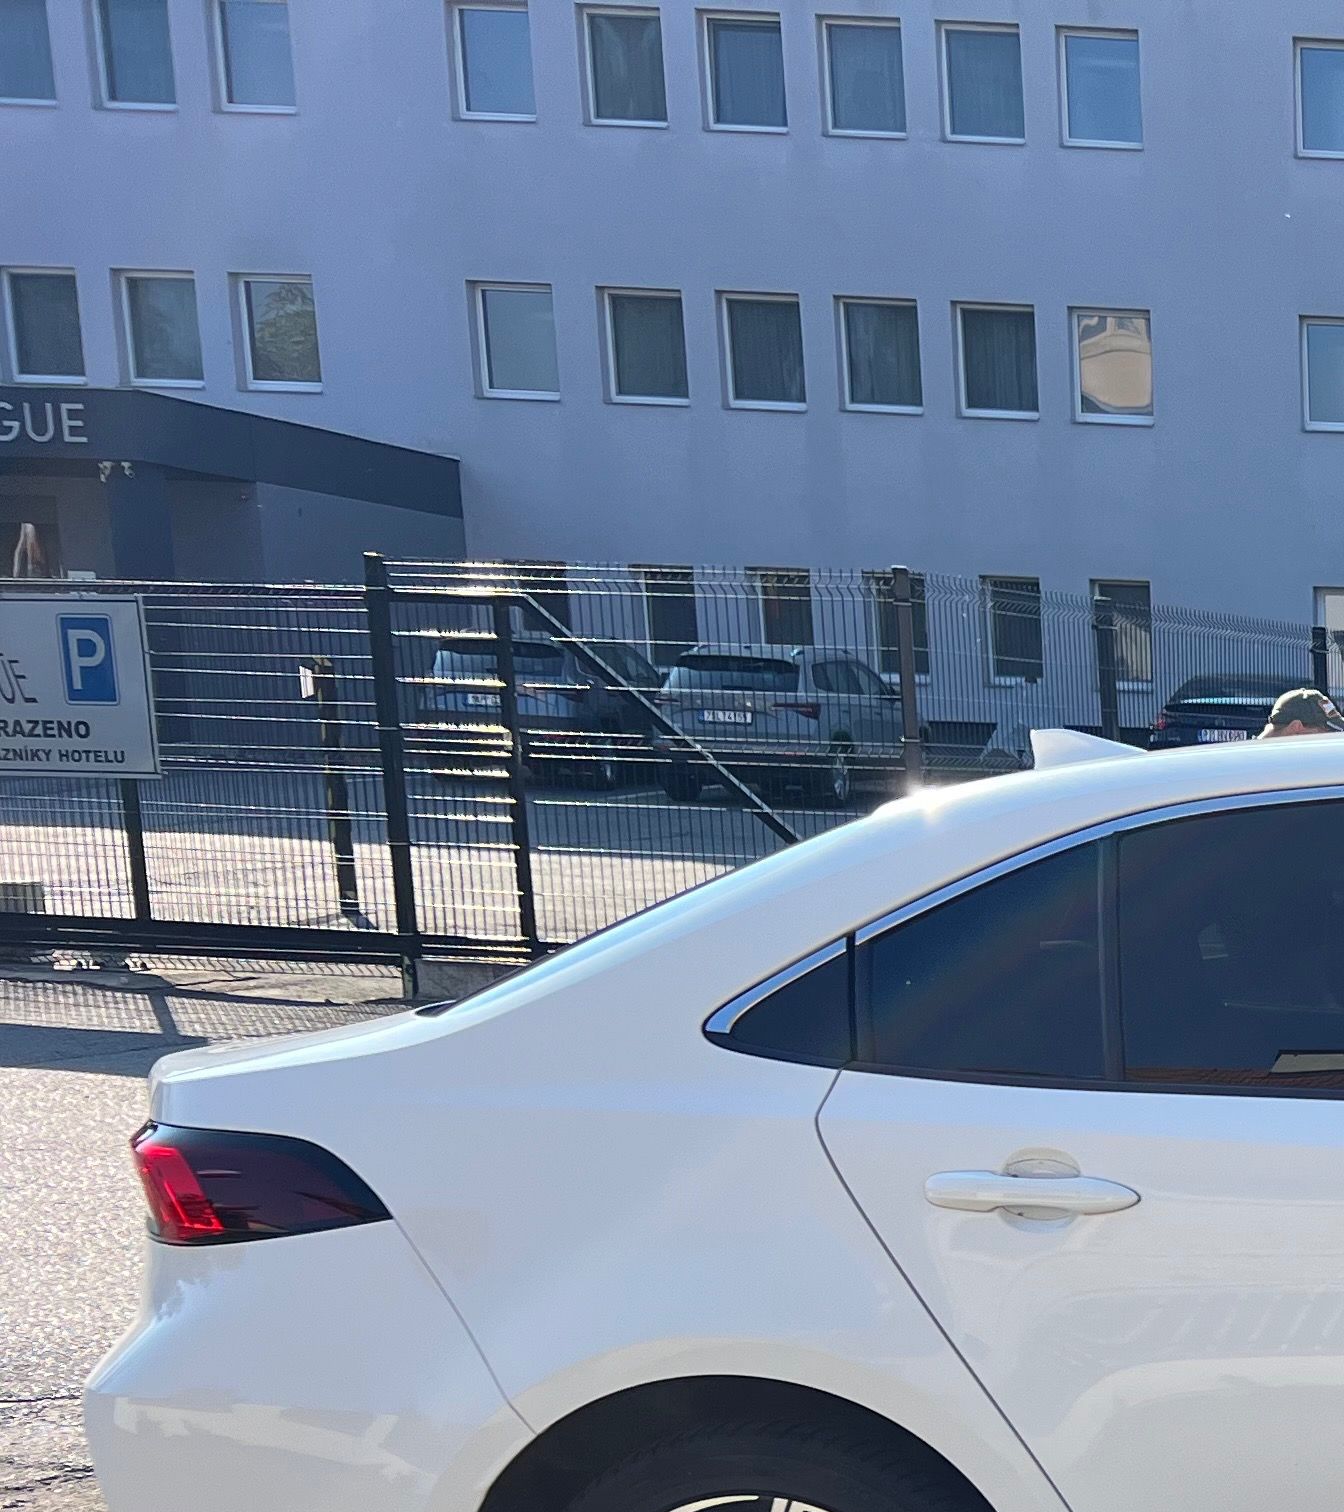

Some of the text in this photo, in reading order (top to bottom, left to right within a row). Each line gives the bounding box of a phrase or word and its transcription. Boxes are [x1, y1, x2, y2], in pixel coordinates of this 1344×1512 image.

[0, 402, 88, 442] GUE
[67, 629, 105, 690] P
[0, 719, 91, 738] RAZENO
[59, 750, 126, 763] HOTELU
